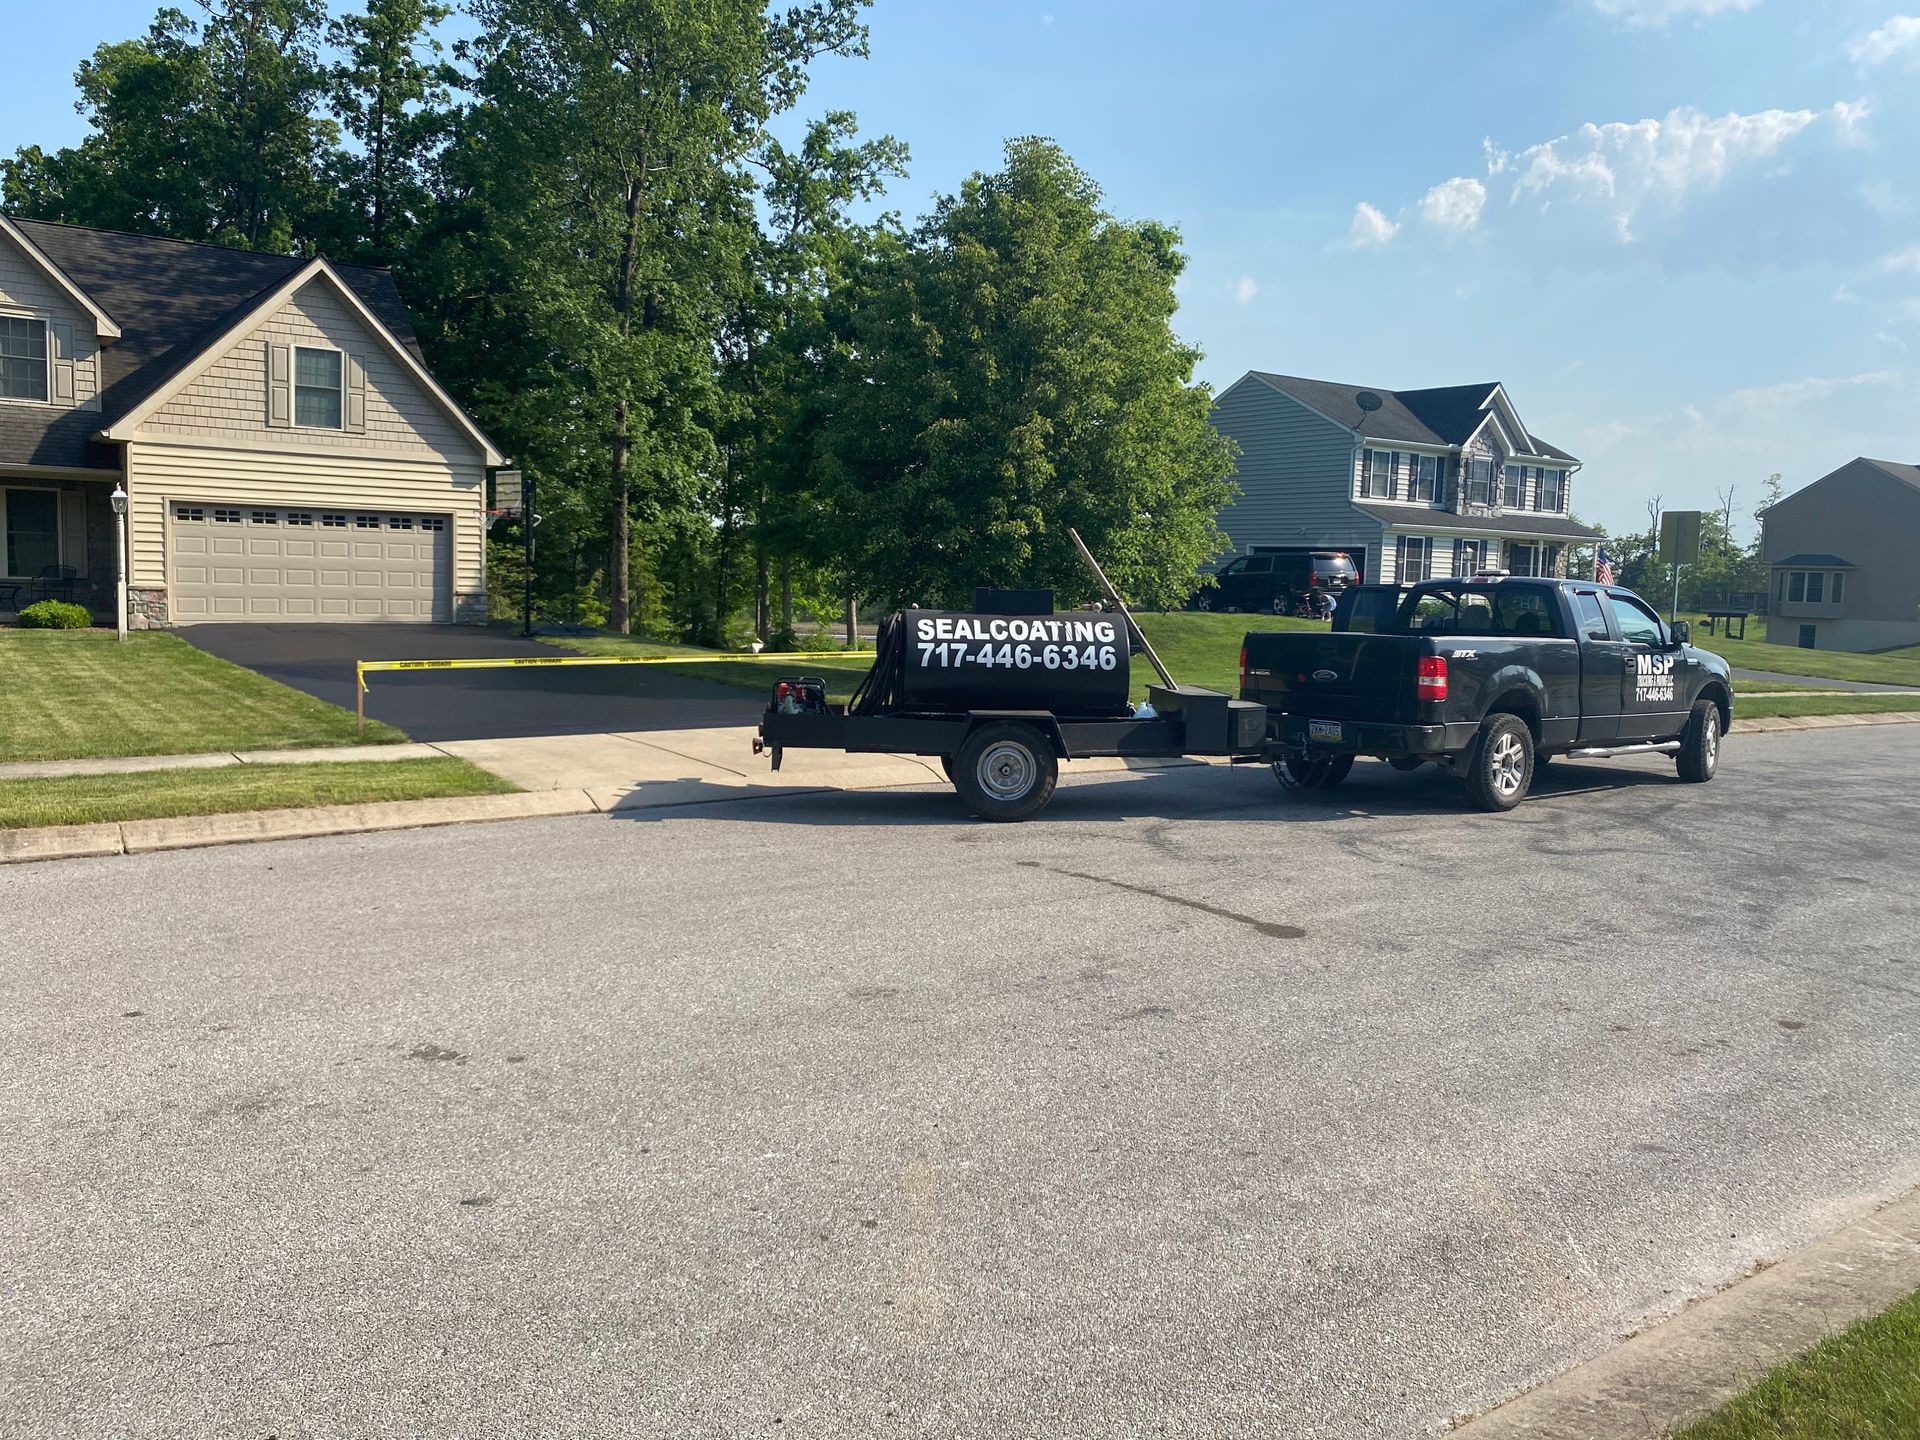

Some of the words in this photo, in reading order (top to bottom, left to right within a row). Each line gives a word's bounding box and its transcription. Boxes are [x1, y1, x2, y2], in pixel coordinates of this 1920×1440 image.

[917, 618, 1115, 642] SEALCOATING
[917, 642, 1117, 671] 717-446-6346
[1451, 649, 1477, 658] STX
[1636, 654, 1674, 675] MSP
[1635, 687, 1674, 702] 717-446-6346
